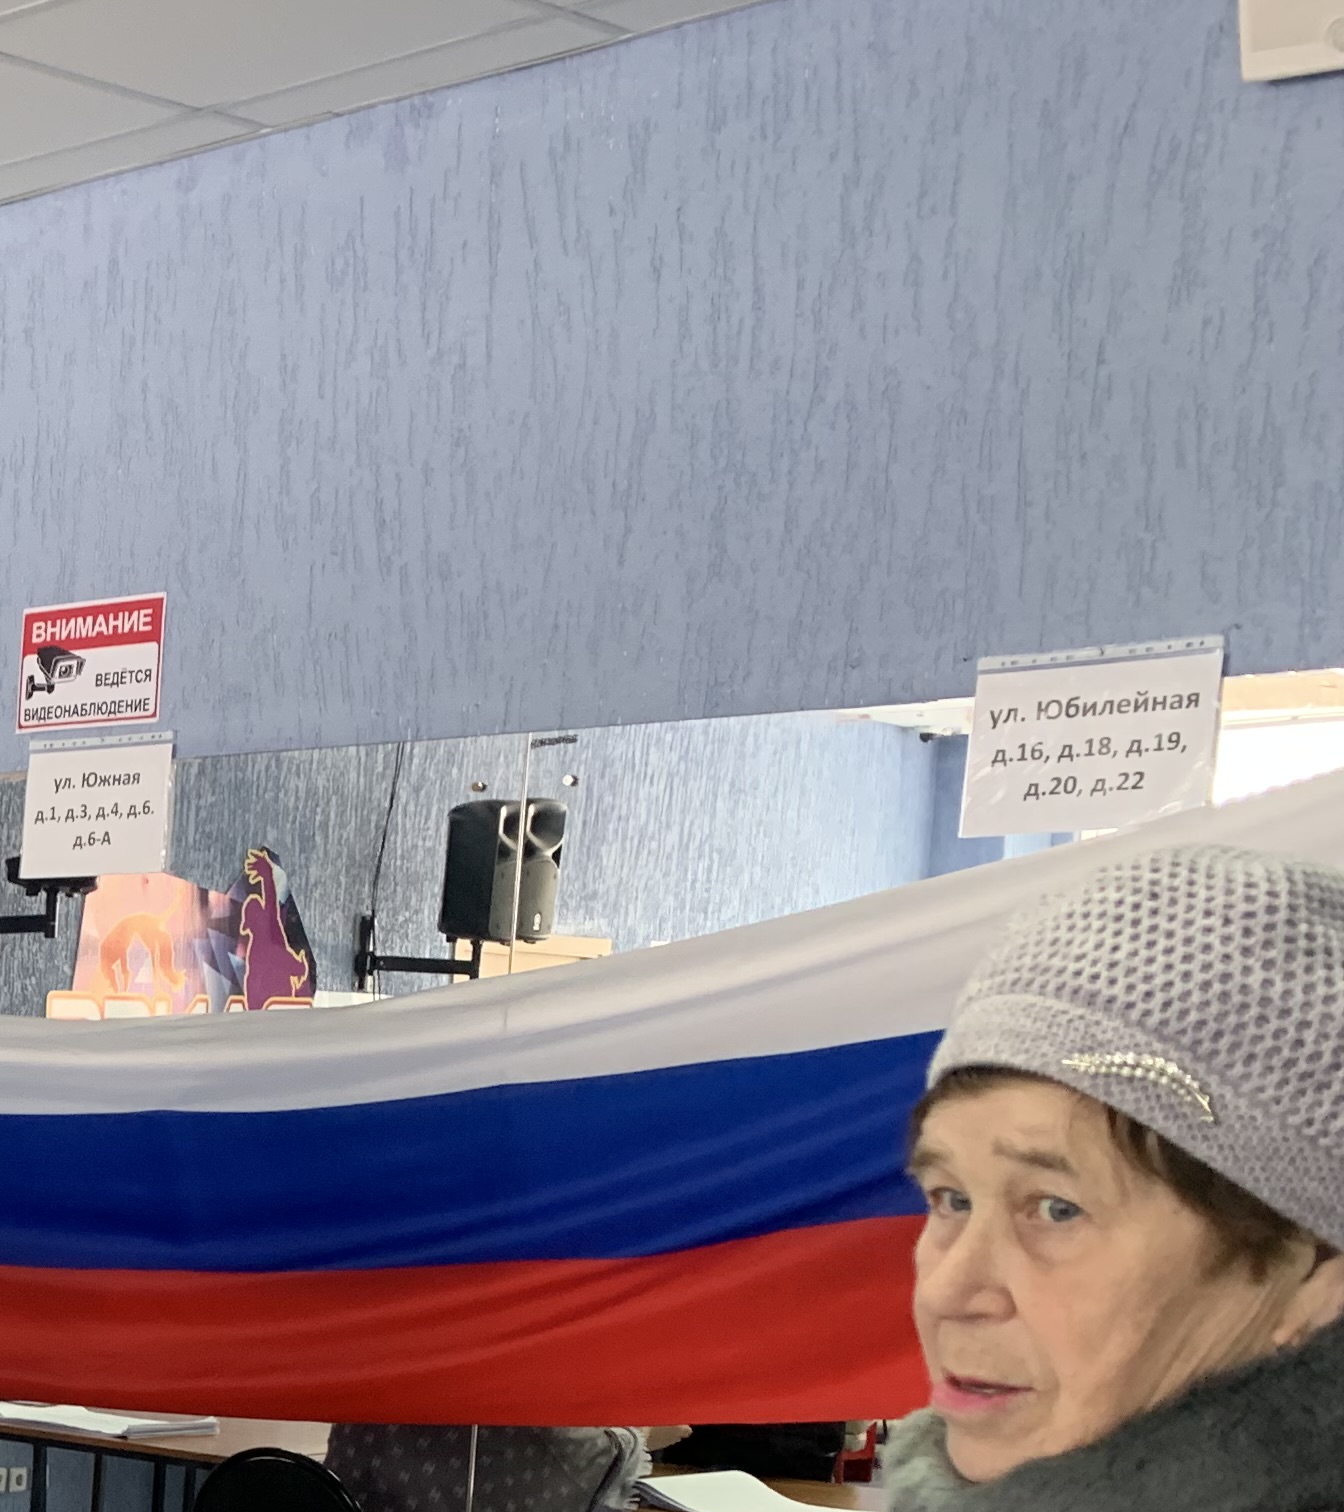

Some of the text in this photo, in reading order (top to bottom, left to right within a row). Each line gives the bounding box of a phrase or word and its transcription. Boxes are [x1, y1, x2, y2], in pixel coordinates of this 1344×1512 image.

[31, 608, 154, 644] ВНИМАНИЕ
[95, 668, 152, 688] ВЕДЁТСЯ
[23, 697, 151, 723] ВИДЕОНАБЛЮДЕНИЕ
[988, 689, 1201, 728] ул. Юбилейная
[990, 731, 1188, 767] д.16, д.18, д.19,
[53, 771, 141, 794] ул. Южная
[1022, 770, 1146, 802] д.20, д.22
[34, 806, 61, 825] д.1,
[64, 803, 92, 822] д.3,
[95, 802, 123, 821] д.4,
[72, 831, 112, 850] д.6-А
